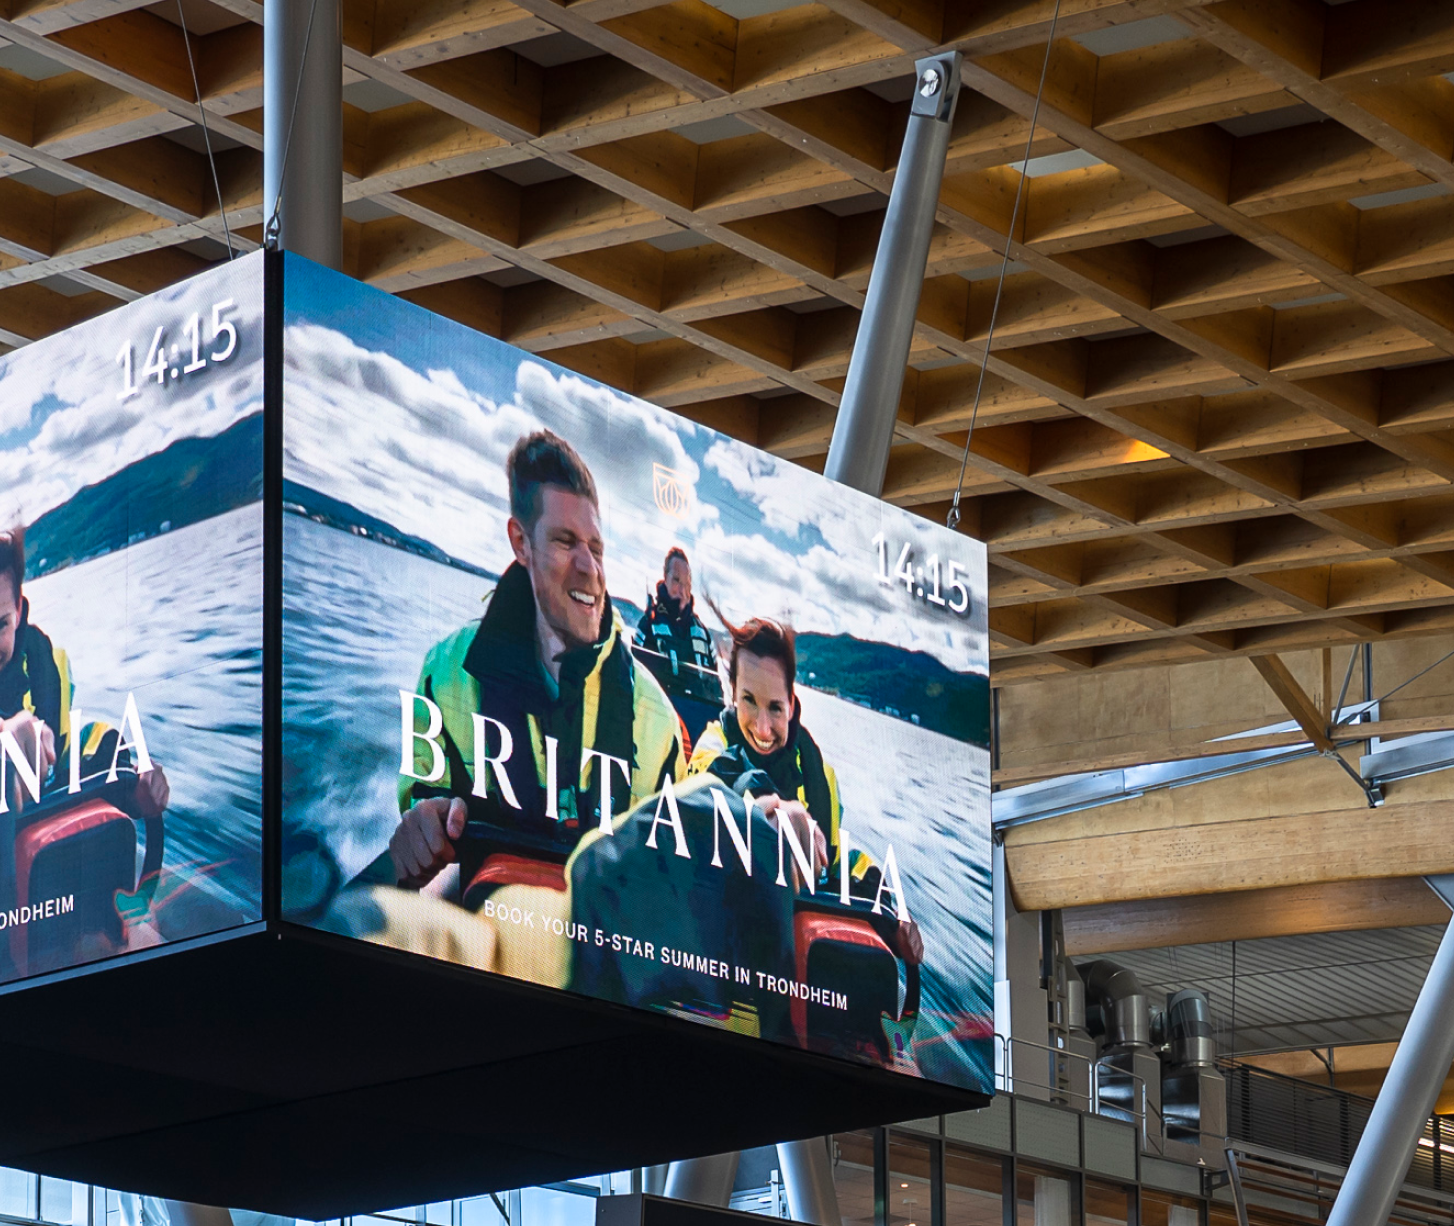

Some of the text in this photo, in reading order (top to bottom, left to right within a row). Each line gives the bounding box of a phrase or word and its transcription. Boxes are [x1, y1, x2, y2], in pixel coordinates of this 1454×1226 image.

[116, 298, 237, 398] 14:15
[871, 530, 970, 614] 14:15
[398, 688, 913, 922] BRITANNIA
[484, 899, 848, 1011] BOOK YOUR 5-STAR SUMMER IN TRONDHEIM
